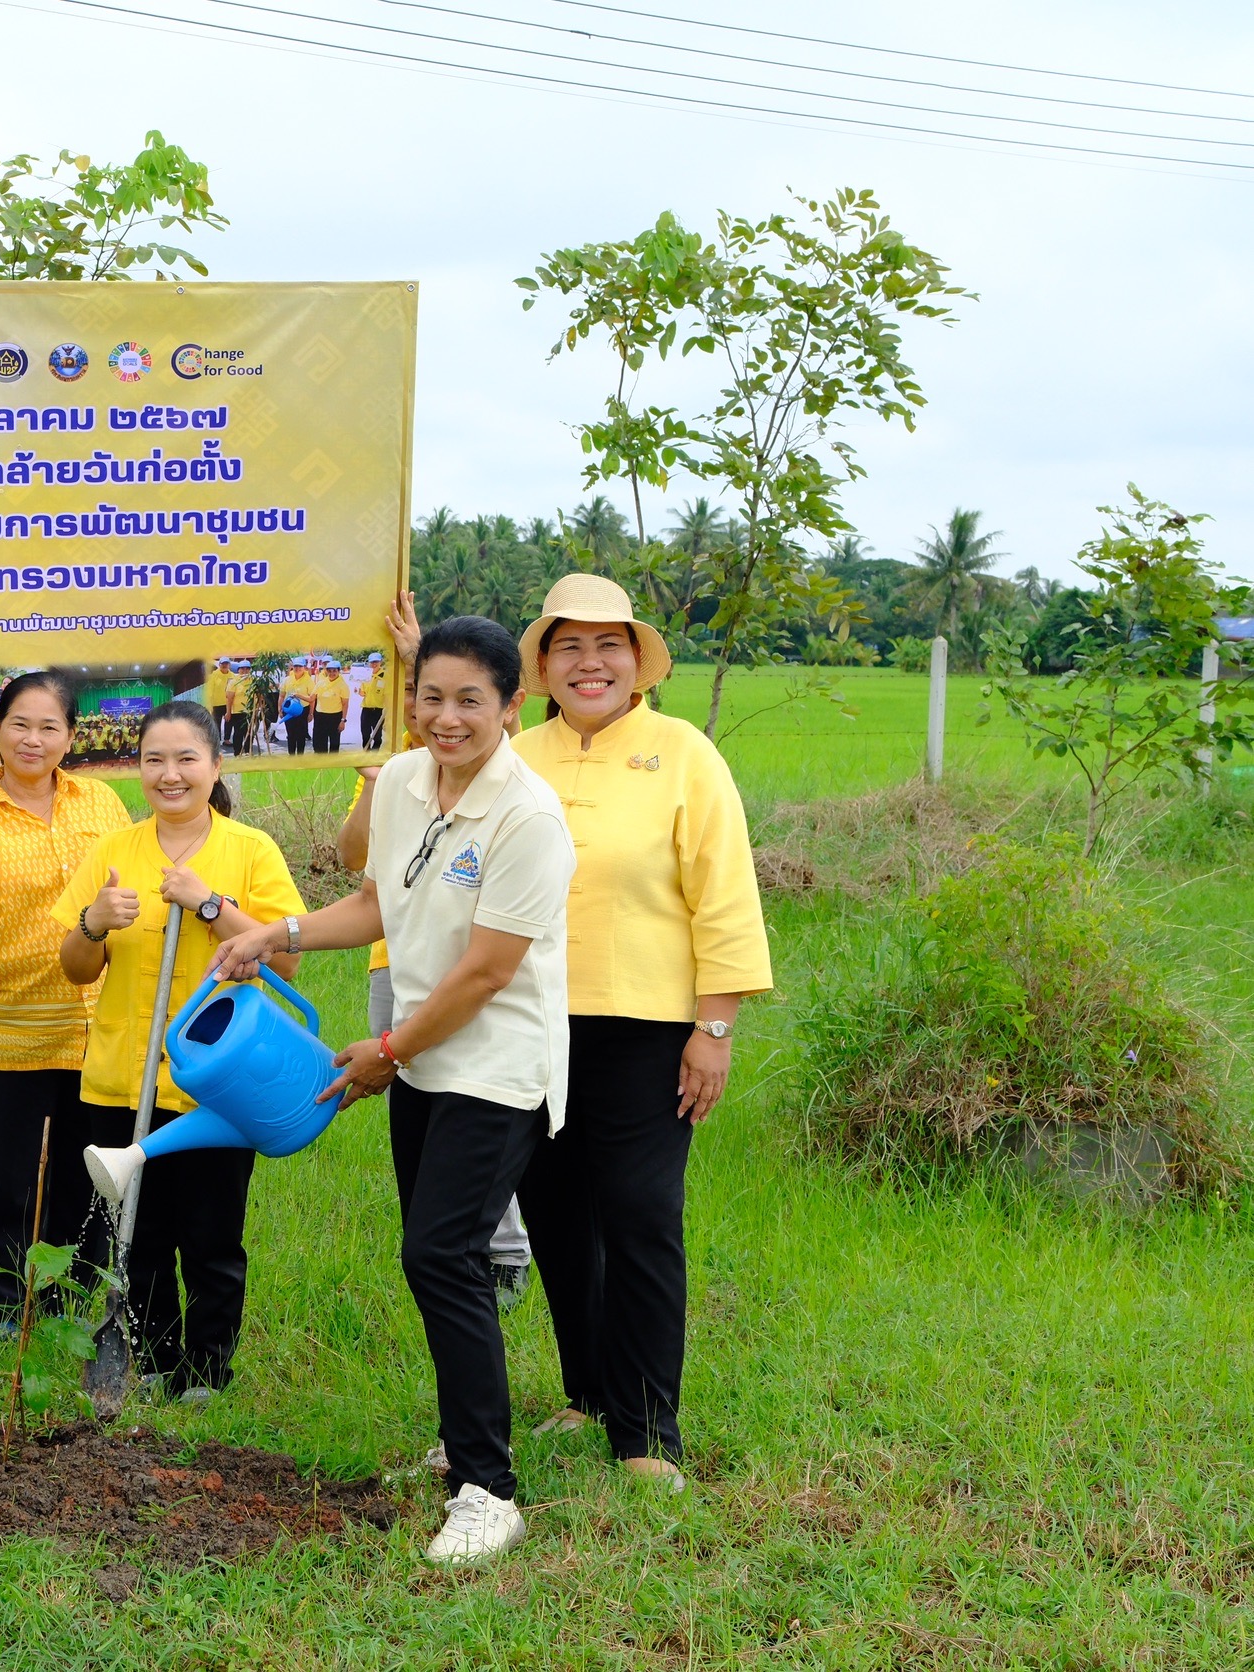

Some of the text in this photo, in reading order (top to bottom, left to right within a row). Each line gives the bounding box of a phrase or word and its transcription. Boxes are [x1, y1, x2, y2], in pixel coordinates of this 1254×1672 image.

[204, 364, 263, 376] for Good
[110, 405, 227, 430] ๒๕๖๗
